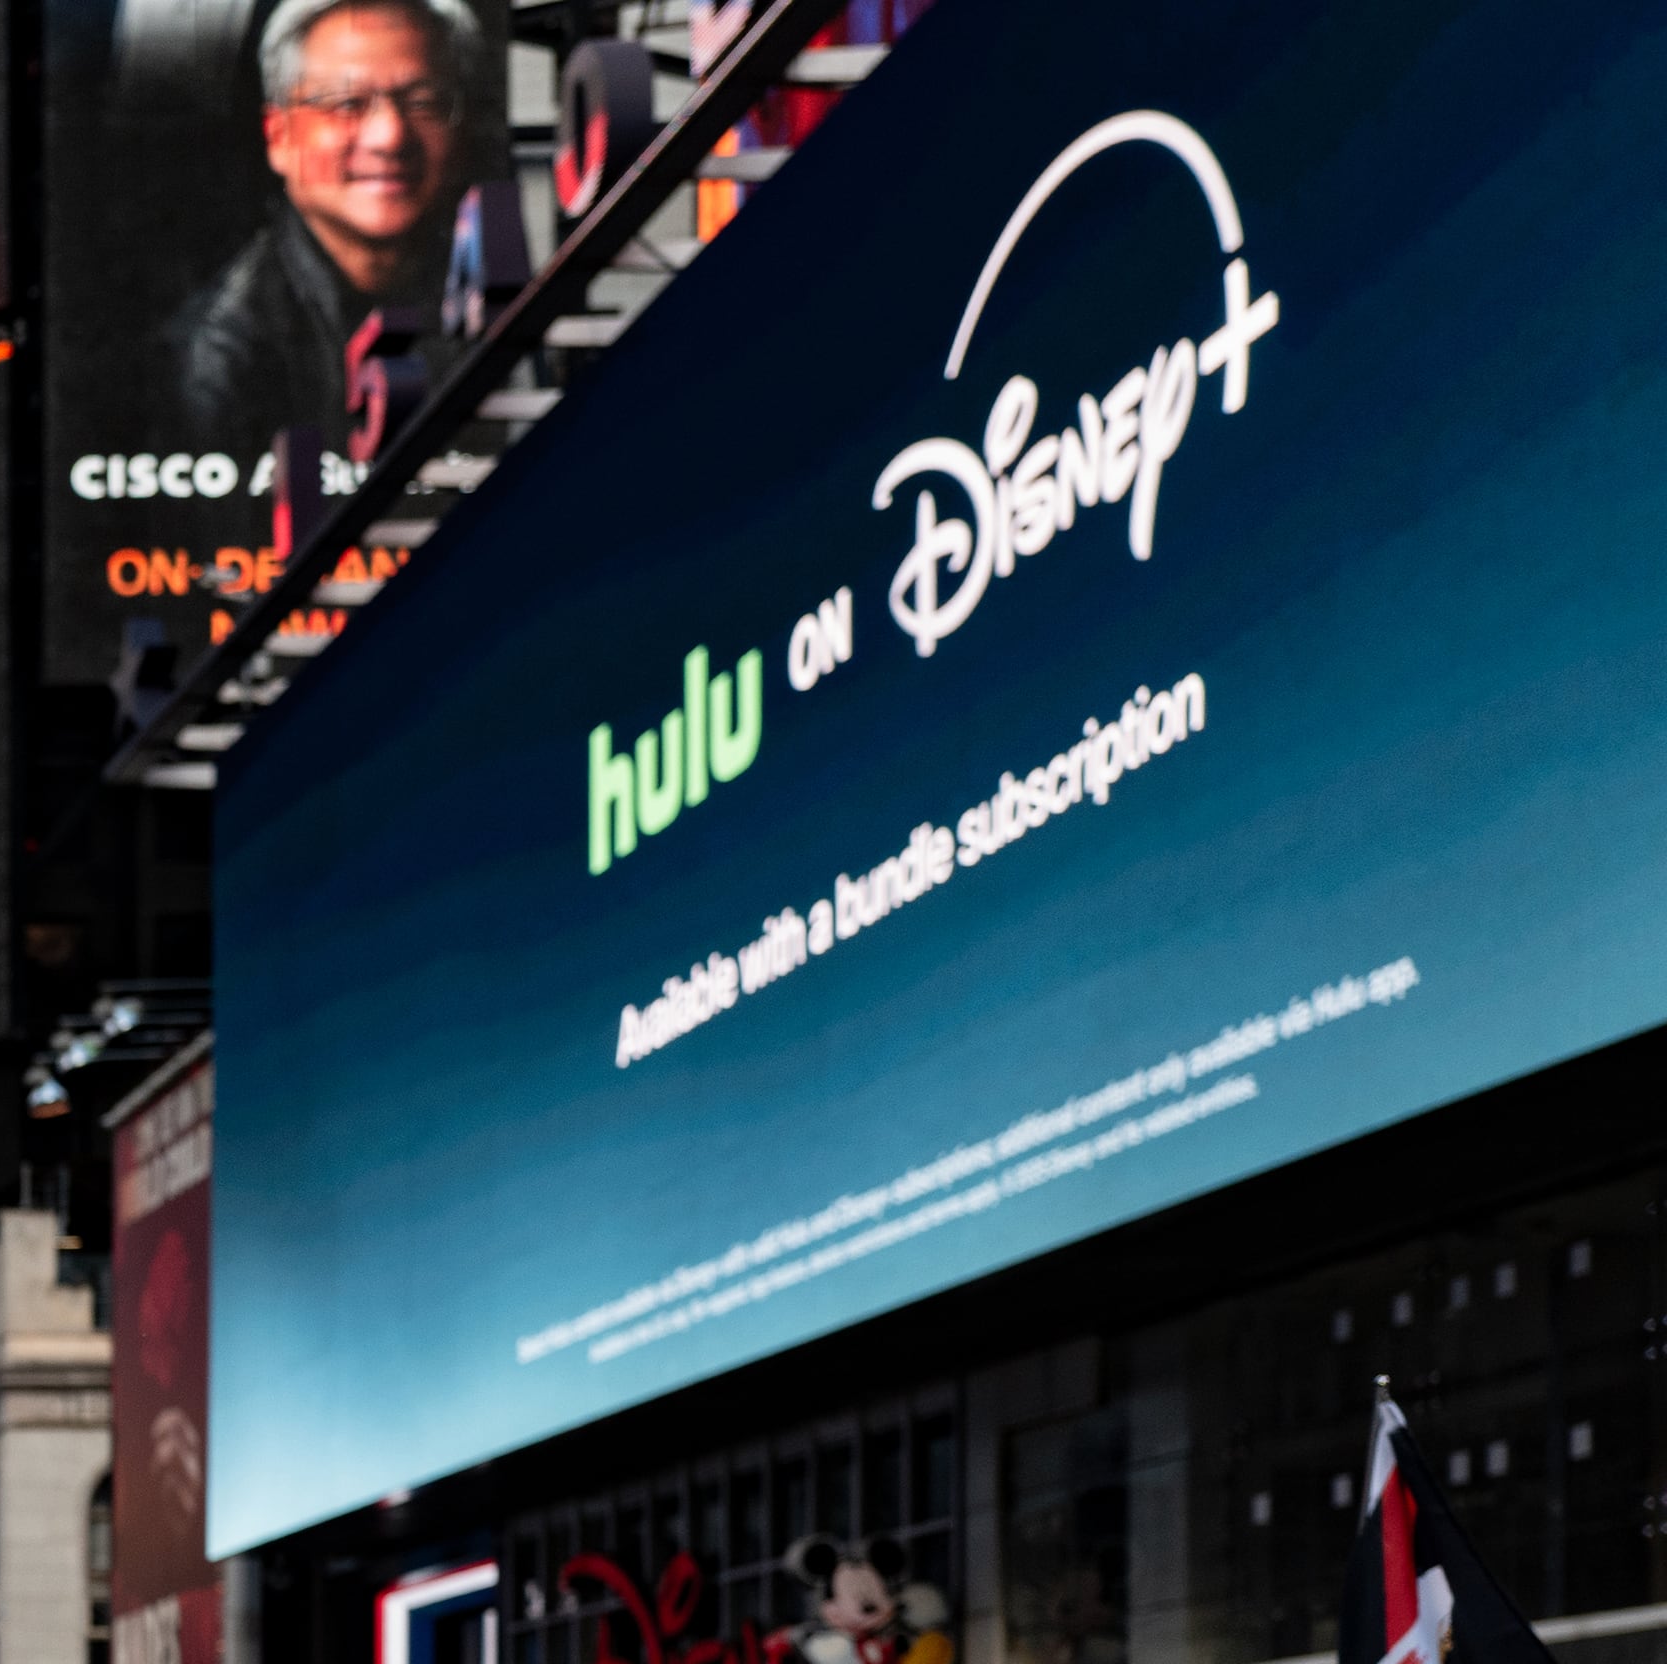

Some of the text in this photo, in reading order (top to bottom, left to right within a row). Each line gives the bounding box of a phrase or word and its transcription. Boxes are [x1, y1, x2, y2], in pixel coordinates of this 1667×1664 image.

[69, 450, 240, 500] CISCO
[588, 585, 854, 876] hulu ON
[615, 672, 1206, 1069] Available with a bundle subscription
